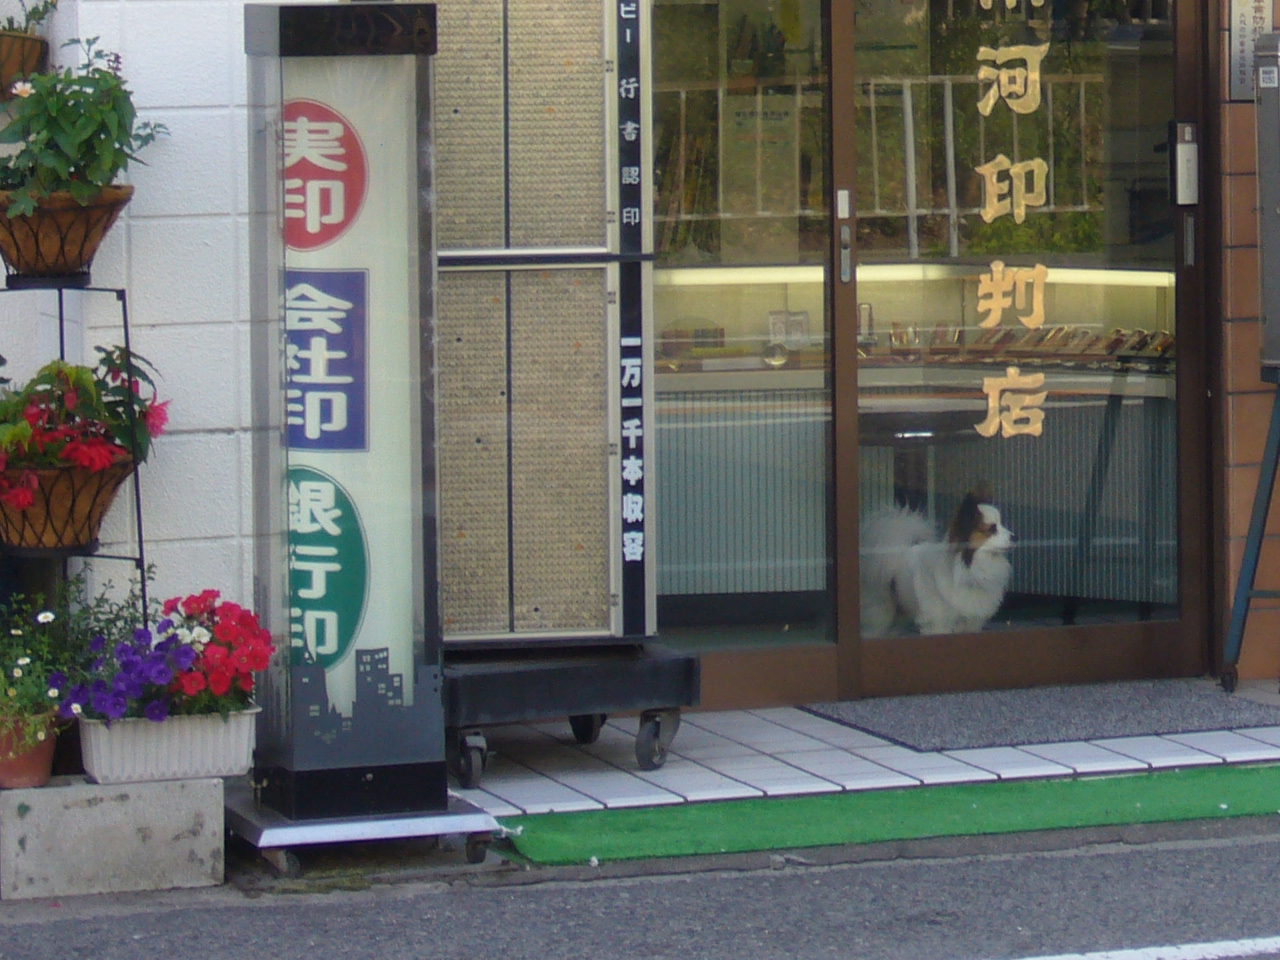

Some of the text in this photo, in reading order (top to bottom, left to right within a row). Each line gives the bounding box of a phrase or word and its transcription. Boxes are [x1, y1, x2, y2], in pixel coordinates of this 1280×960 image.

[282, 116, 348, 234] 実印
[620, 337, 645, 562] 一万一千本収容
